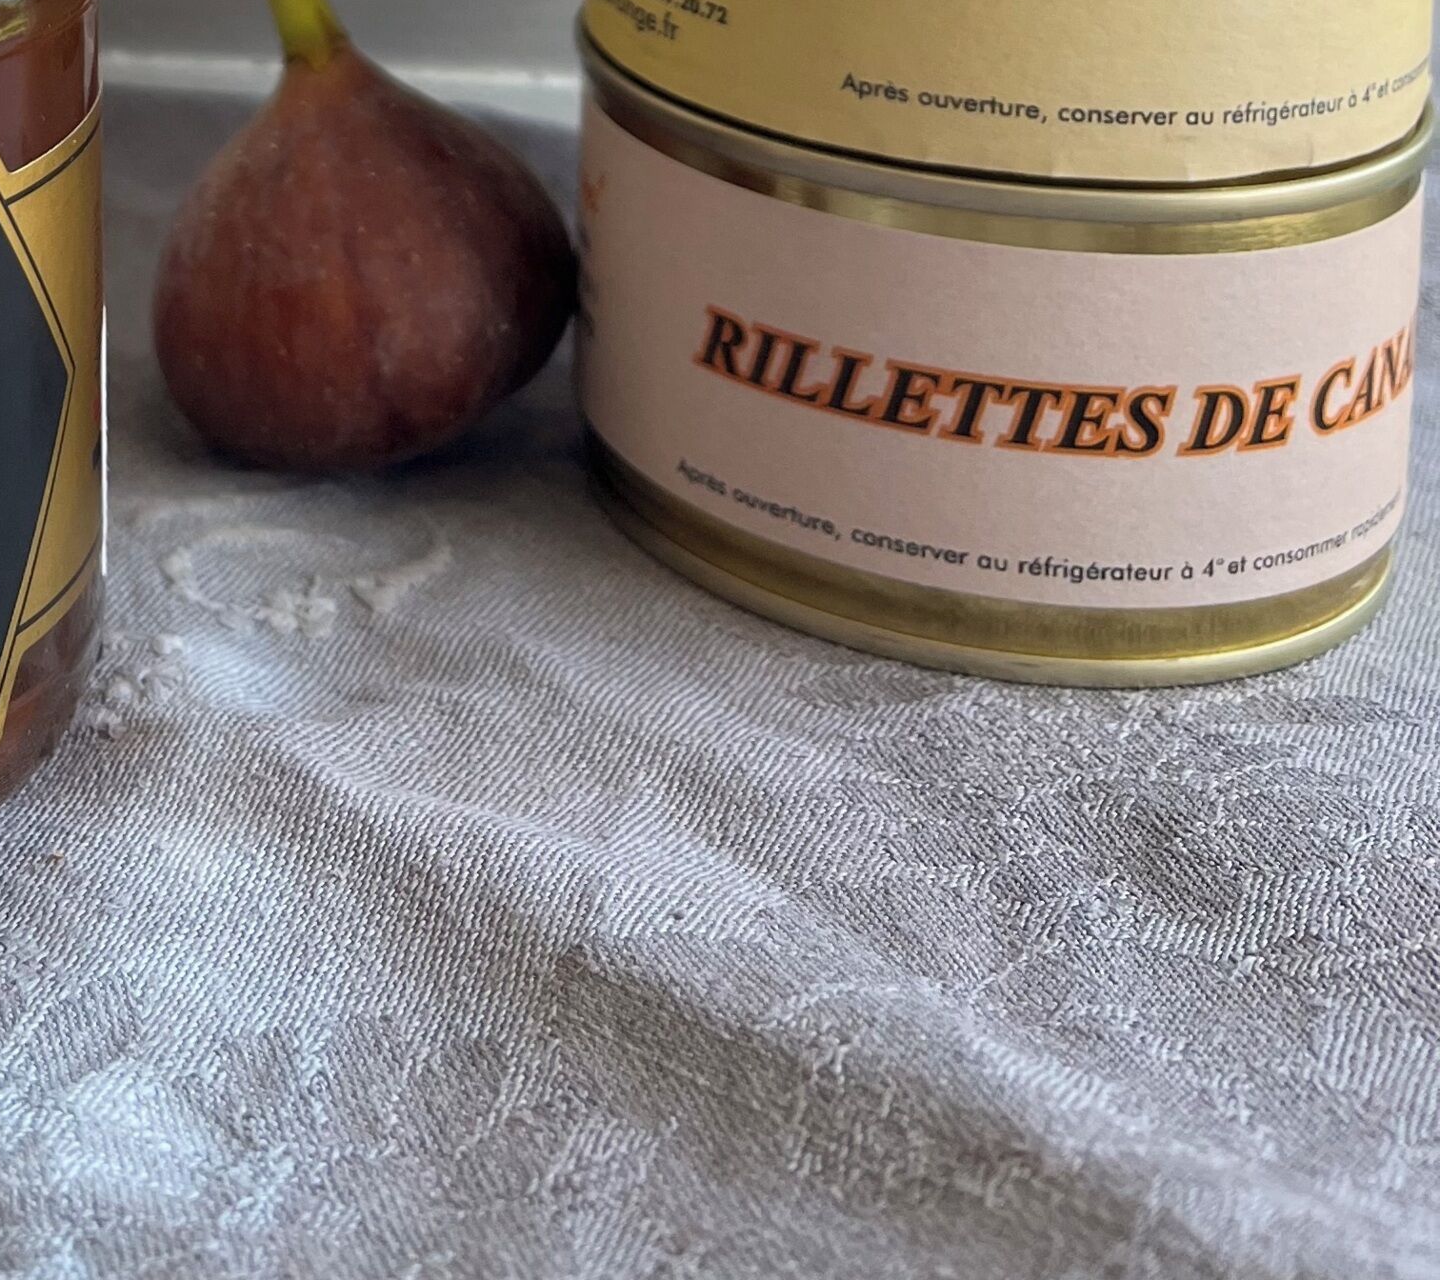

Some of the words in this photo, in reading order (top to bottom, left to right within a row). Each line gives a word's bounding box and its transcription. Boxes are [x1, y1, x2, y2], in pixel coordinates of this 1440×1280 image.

[840, 72, 909, 102] Après
[918, 90, 1047, 124] ouverture,
[1057, 104, 1177, 127] conserver
[1185, 110, 1214, 126] au
[1223, 92, 1344, 127] réfrigérateur
[1348, 90, 1358, 109] à
[692, 304, 1178, 459] RILLETTES
[1176, 374, 1302, 457] DE
[676, 458, 728, 496] Après
[732, 486, 842, 541] ouverture,
[851, 526, 970, 567] conserver
[977, 552, 1009, 572] au
[1018, 556, 1173, 583] réfrigérateur
[1181, 559, 1193, 579] à
[1228, 557, 1246, 575] et
[1253, 530, 1348, 571] consommer
